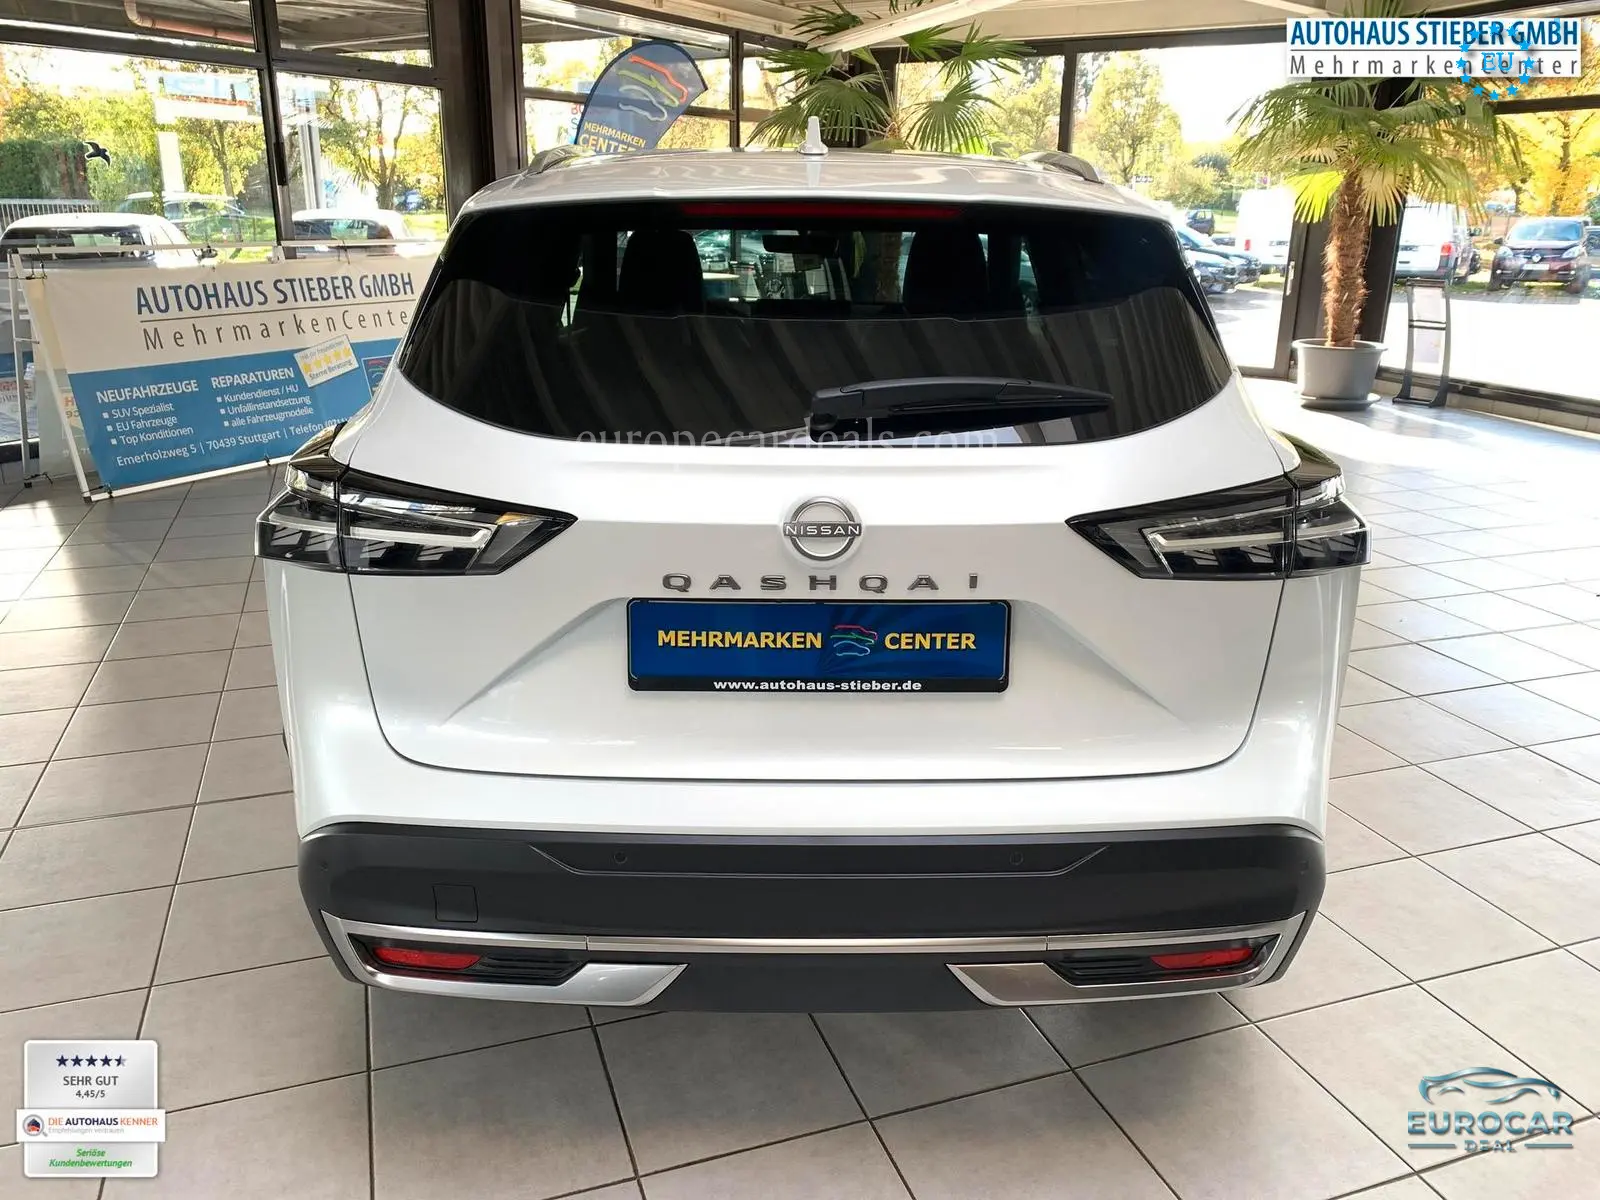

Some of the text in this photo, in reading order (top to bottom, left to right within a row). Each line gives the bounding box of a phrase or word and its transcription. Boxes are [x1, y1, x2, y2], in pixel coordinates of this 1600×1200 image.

[583, 122, 646, 148] MEHRMARKEN
[137, 272, 415, 315] AUTOHAUS STIEBER GMBH
[143, 307, 409, 351] MehrmarkenCente
[211, 367, 295, 389] REPARATUREN
[96, 380, 199, 404] NEUFAHRZEUGE
[223, 387, 281, 403] Kundendienst
[286, 384, 299, 394] HU
[111, 402, 175, 419] SUV Spezialist
[227, 395, 312, 416] Unfallinstandsetzung
[116, 415, 178, 432] EU Fahrzeuge
[231, 406, 314, 428] alle Fahrzeugmodelle
[116, 446, 190, 467] Emerholzweg
[189, 443, 197, 454] 5
[206, 437, 237, 451] 70439
[237, 429, 281, 446] Stuttgart
[289, 422, 324, 436] Telefon
[120, 426, 194, 446] Top Konditionen
[785, 525, 860, 536] NISSAN
[662, 572, 979, 593] QASHQAI
[657, 630, 977, 650] MEHRMARKEN CENTER
[713, 679, 923, 692] www.autohaus-stieber.de
